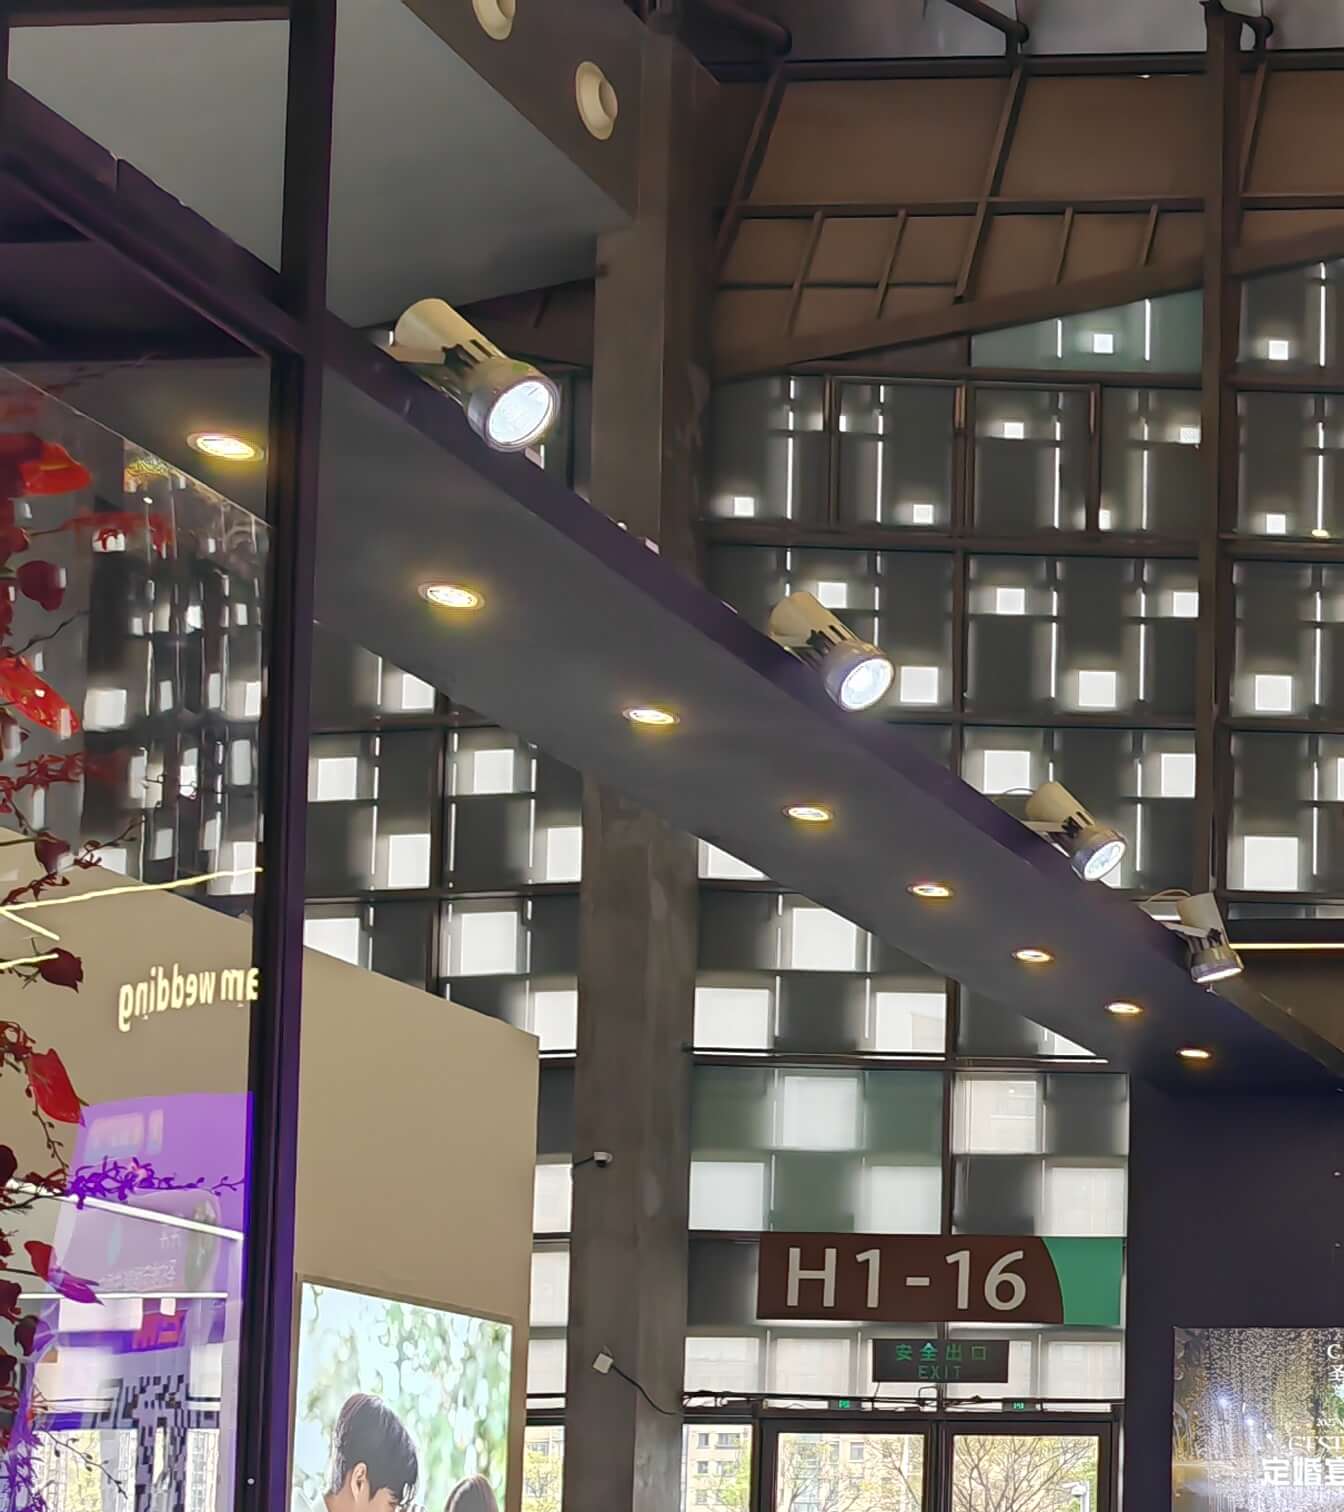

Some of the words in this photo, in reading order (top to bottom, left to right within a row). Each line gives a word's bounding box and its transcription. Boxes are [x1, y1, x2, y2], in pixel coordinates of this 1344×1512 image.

[785, 1247, 1027, 1311] H1-16
[895, 1342, 987, 1362] 安全出口
[918, 1365, 962, 1380] EXIT
